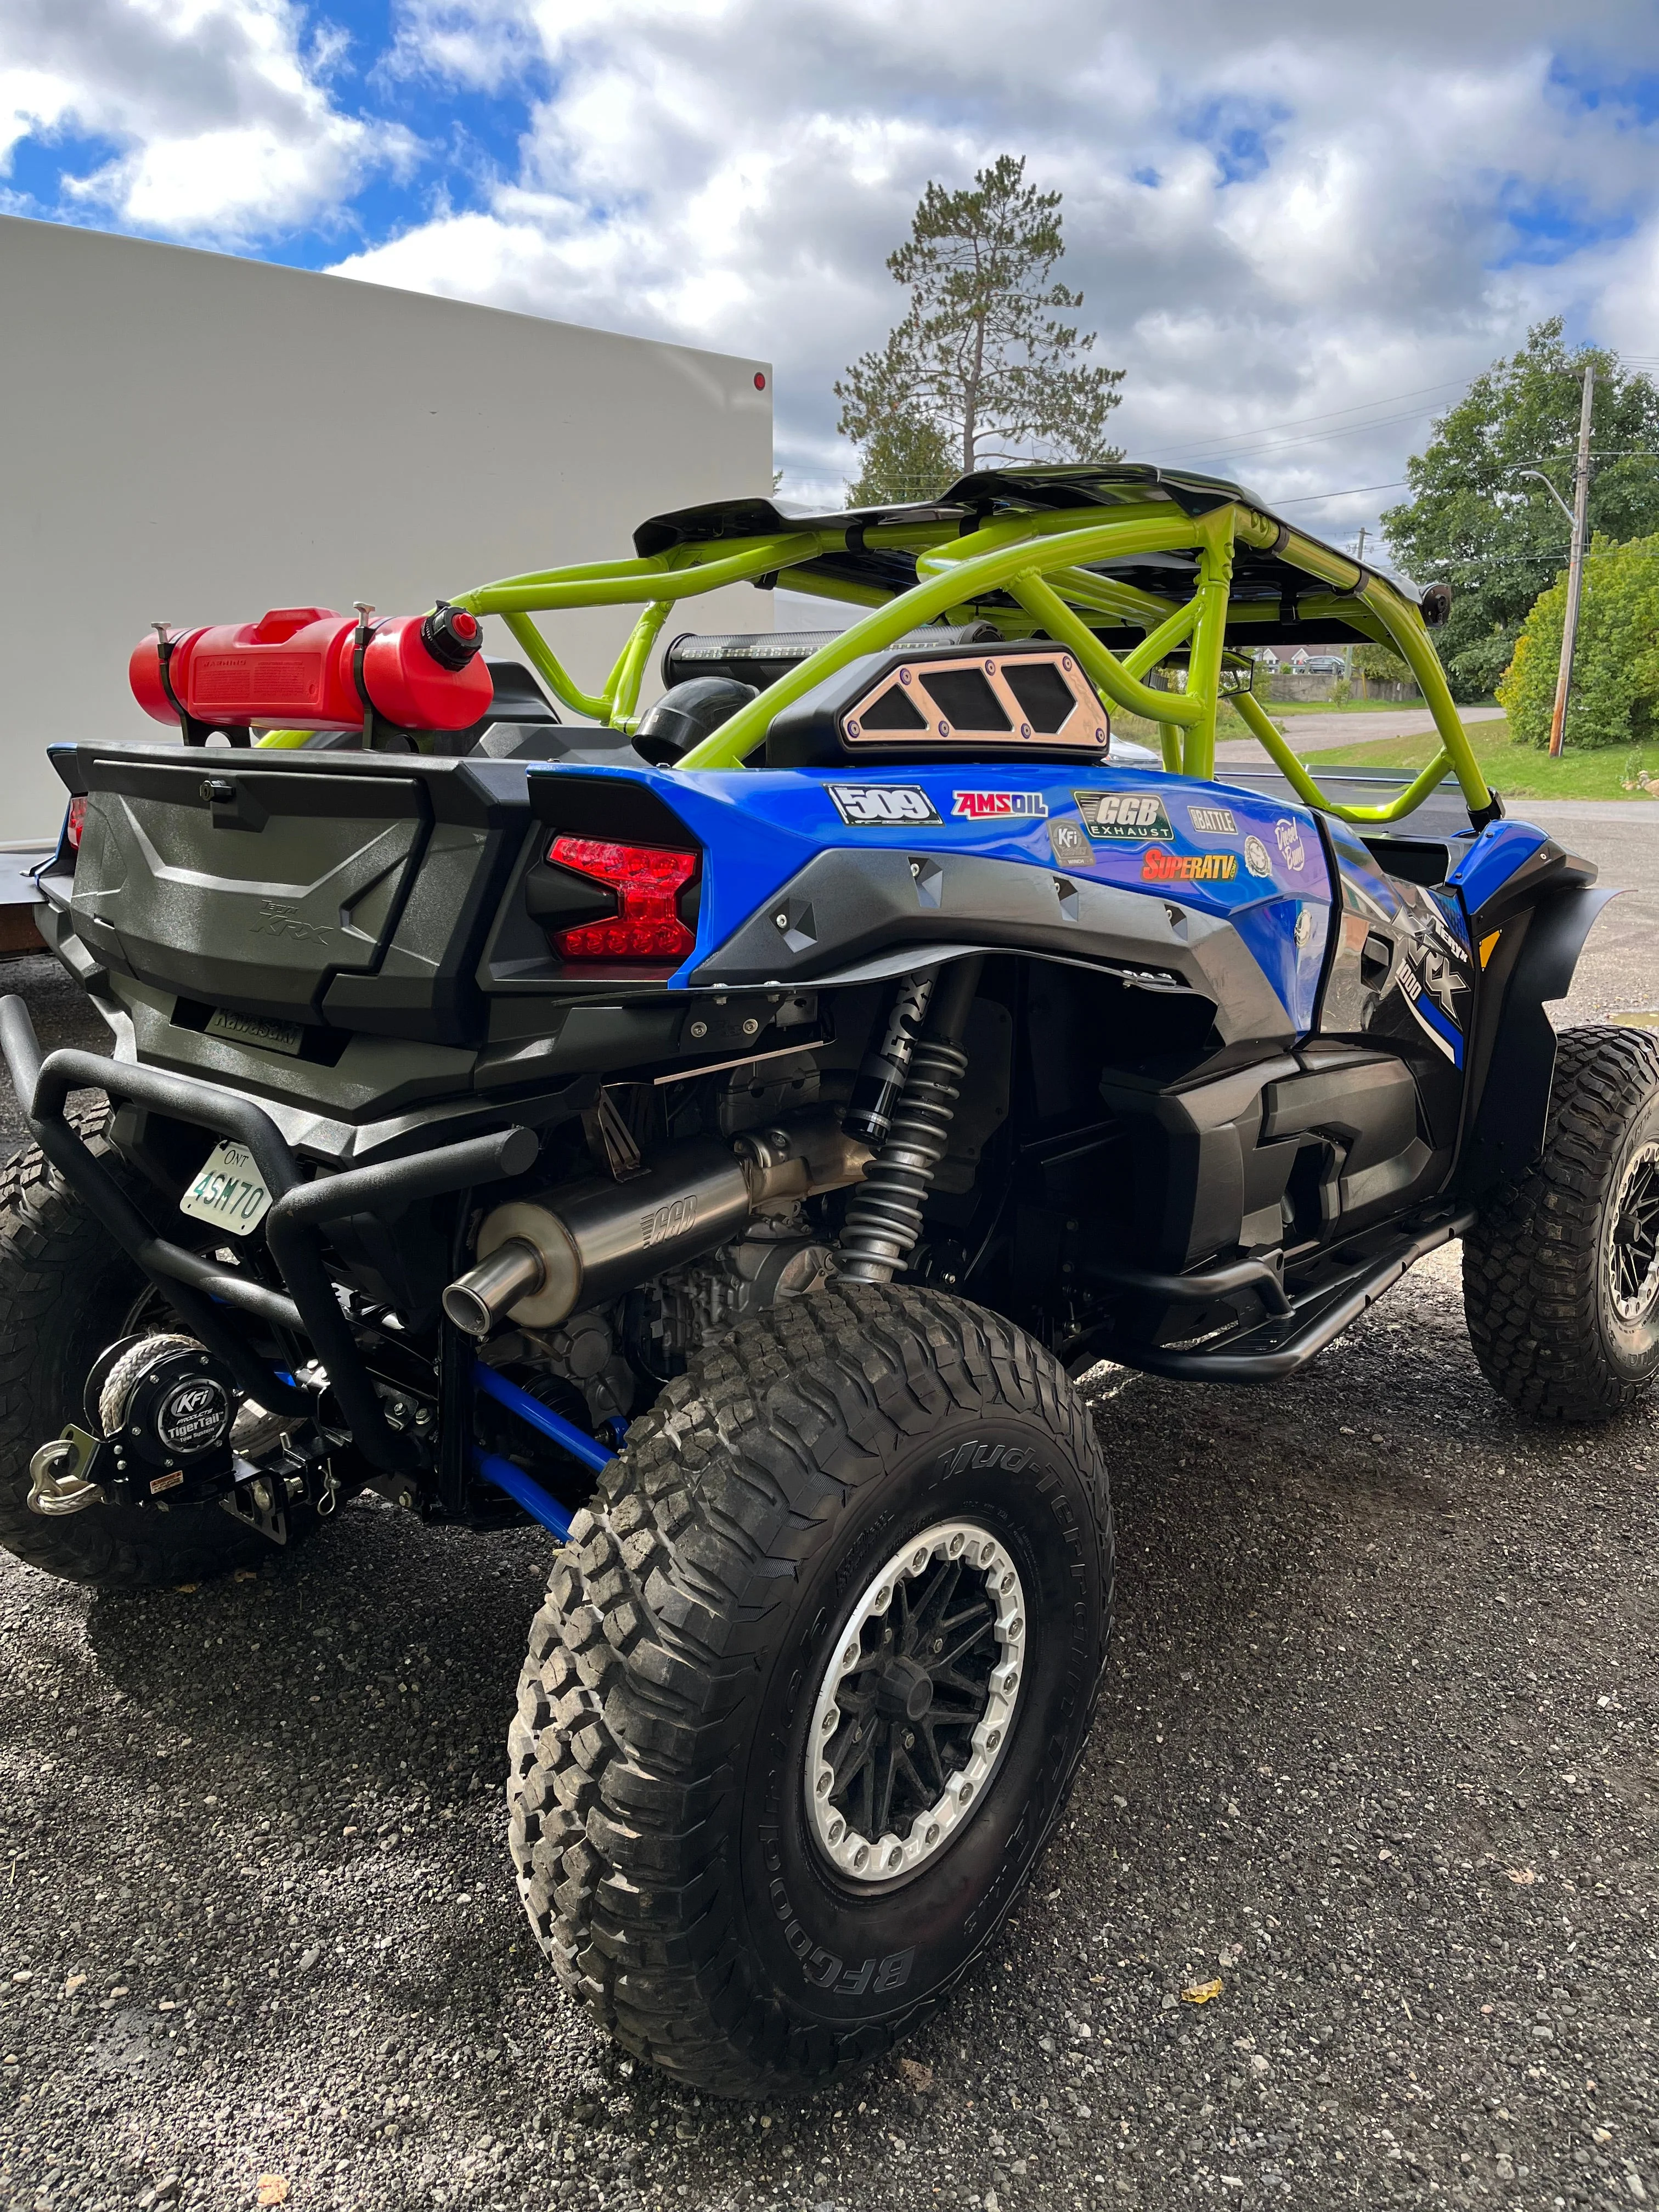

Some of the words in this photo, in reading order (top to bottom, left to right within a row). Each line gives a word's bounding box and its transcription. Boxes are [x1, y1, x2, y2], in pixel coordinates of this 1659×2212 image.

[835, 789, 930, 819] 509
[957, 793, 1046, 816] AMSOIL
[1097, 797, 1159, 826] GGB
[1090, 826, 1169, 837] EXHAUST
[1195, 810, 1235, 832] BATTLE
[249, 912, 334, 945] KRX
[1396, 957, 1422, 1001] 1000
[214, 1008, 300, 1045] Kawasaki
[193, 1170, 264, 1219] 4SM70
[649, 1195, 697, 1246] GGB
[193, 1427, 215, 1437] System
